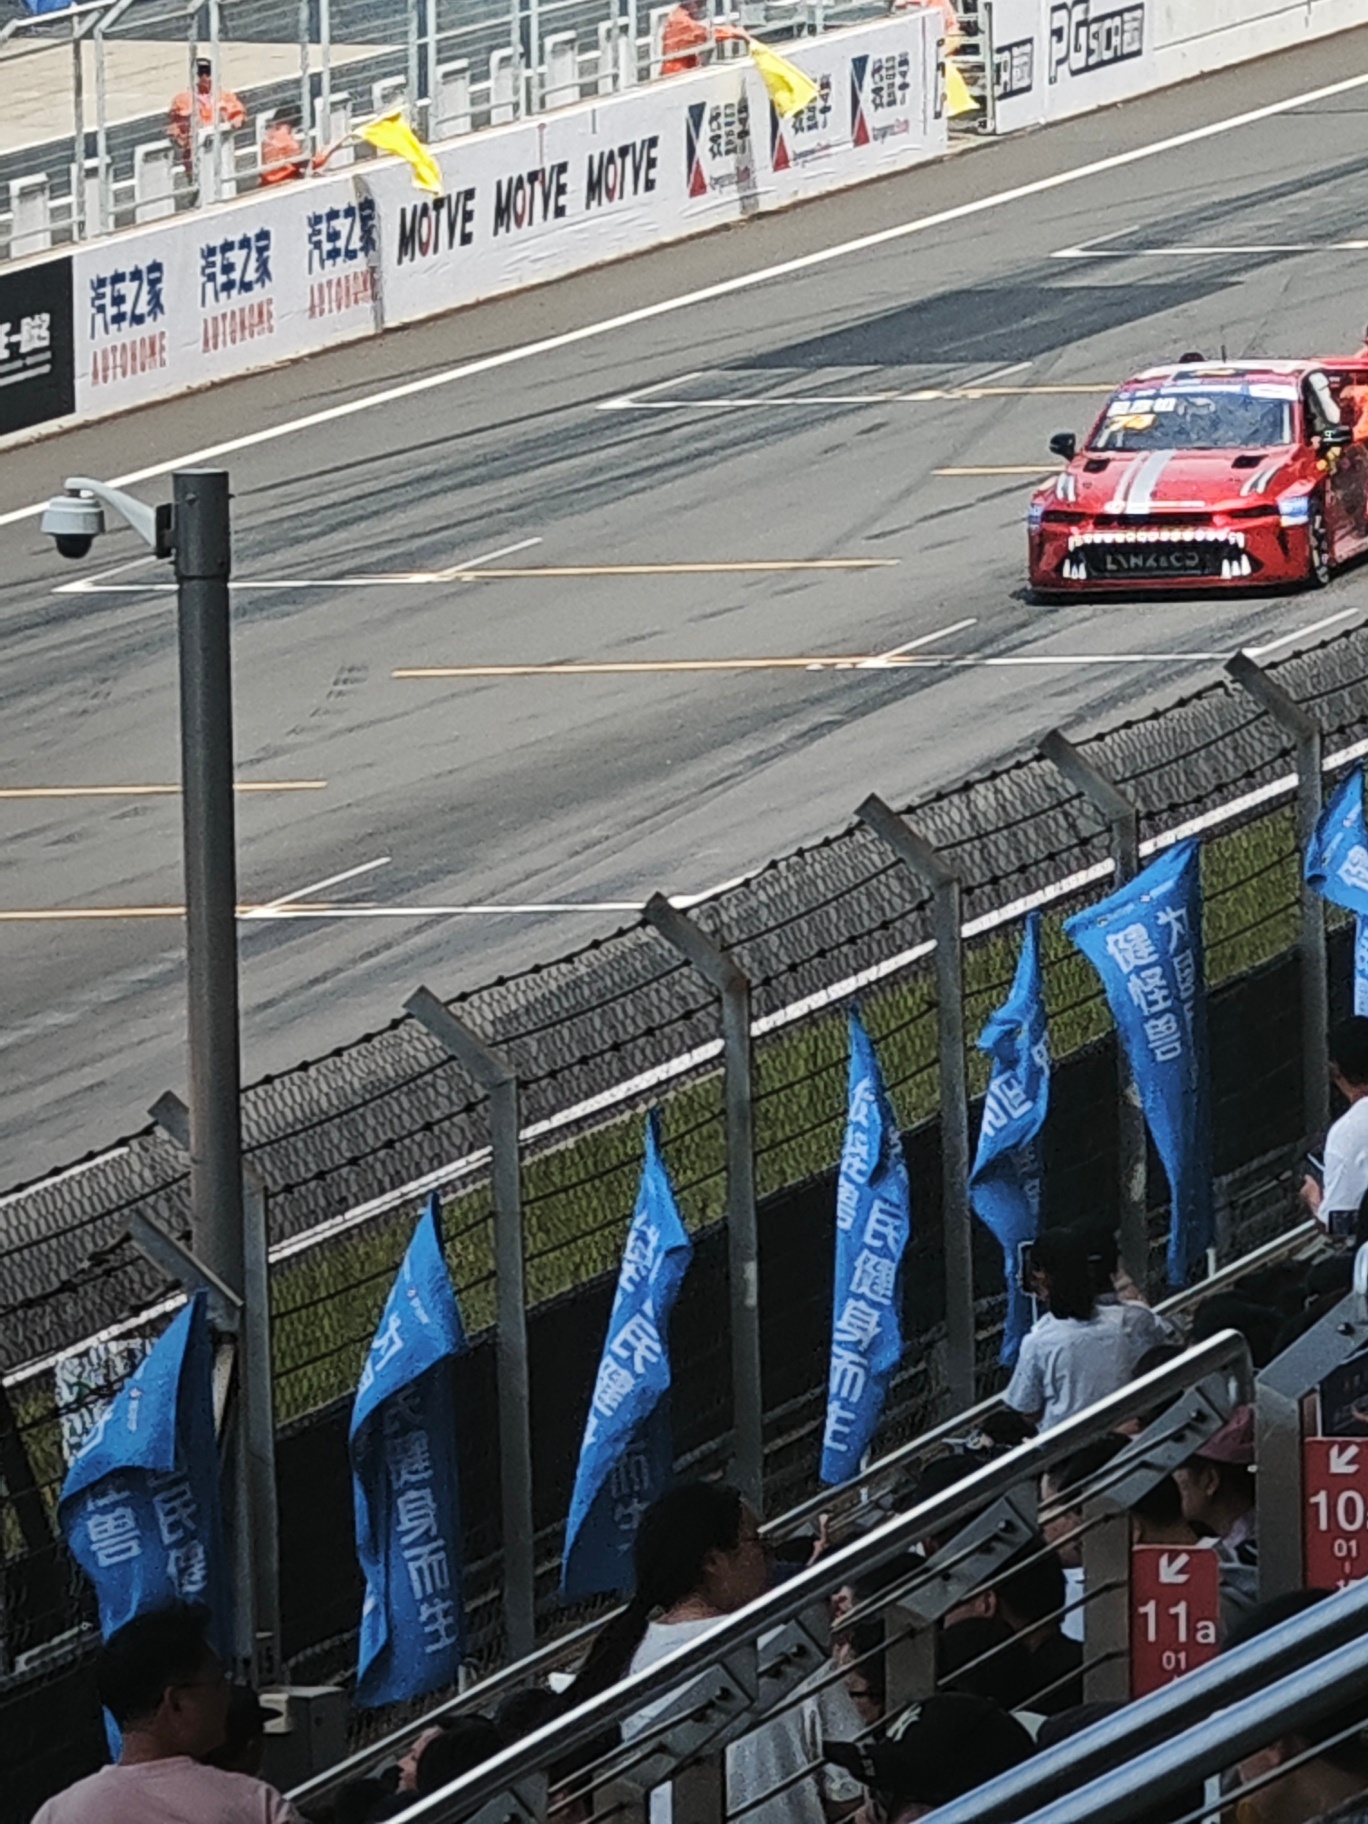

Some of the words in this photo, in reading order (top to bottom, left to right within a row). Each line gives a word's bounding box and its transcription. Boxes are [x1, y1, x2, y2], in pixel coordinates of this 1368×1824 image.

[307, 196, 377, 276] 汽车之家
[200, 227, 274, 308] 汽车之家
[90, 259, 165, 340] 汽车之家
[202, 297, 275, 354] AUTOHOME
[91, 330, 168, 387] AUTOHOME
[1333, 1538, 1359, 1559] 01
[1138, 1600, 1217, 1645] 11a
[1161, 1651, 1187, 1671] 01
